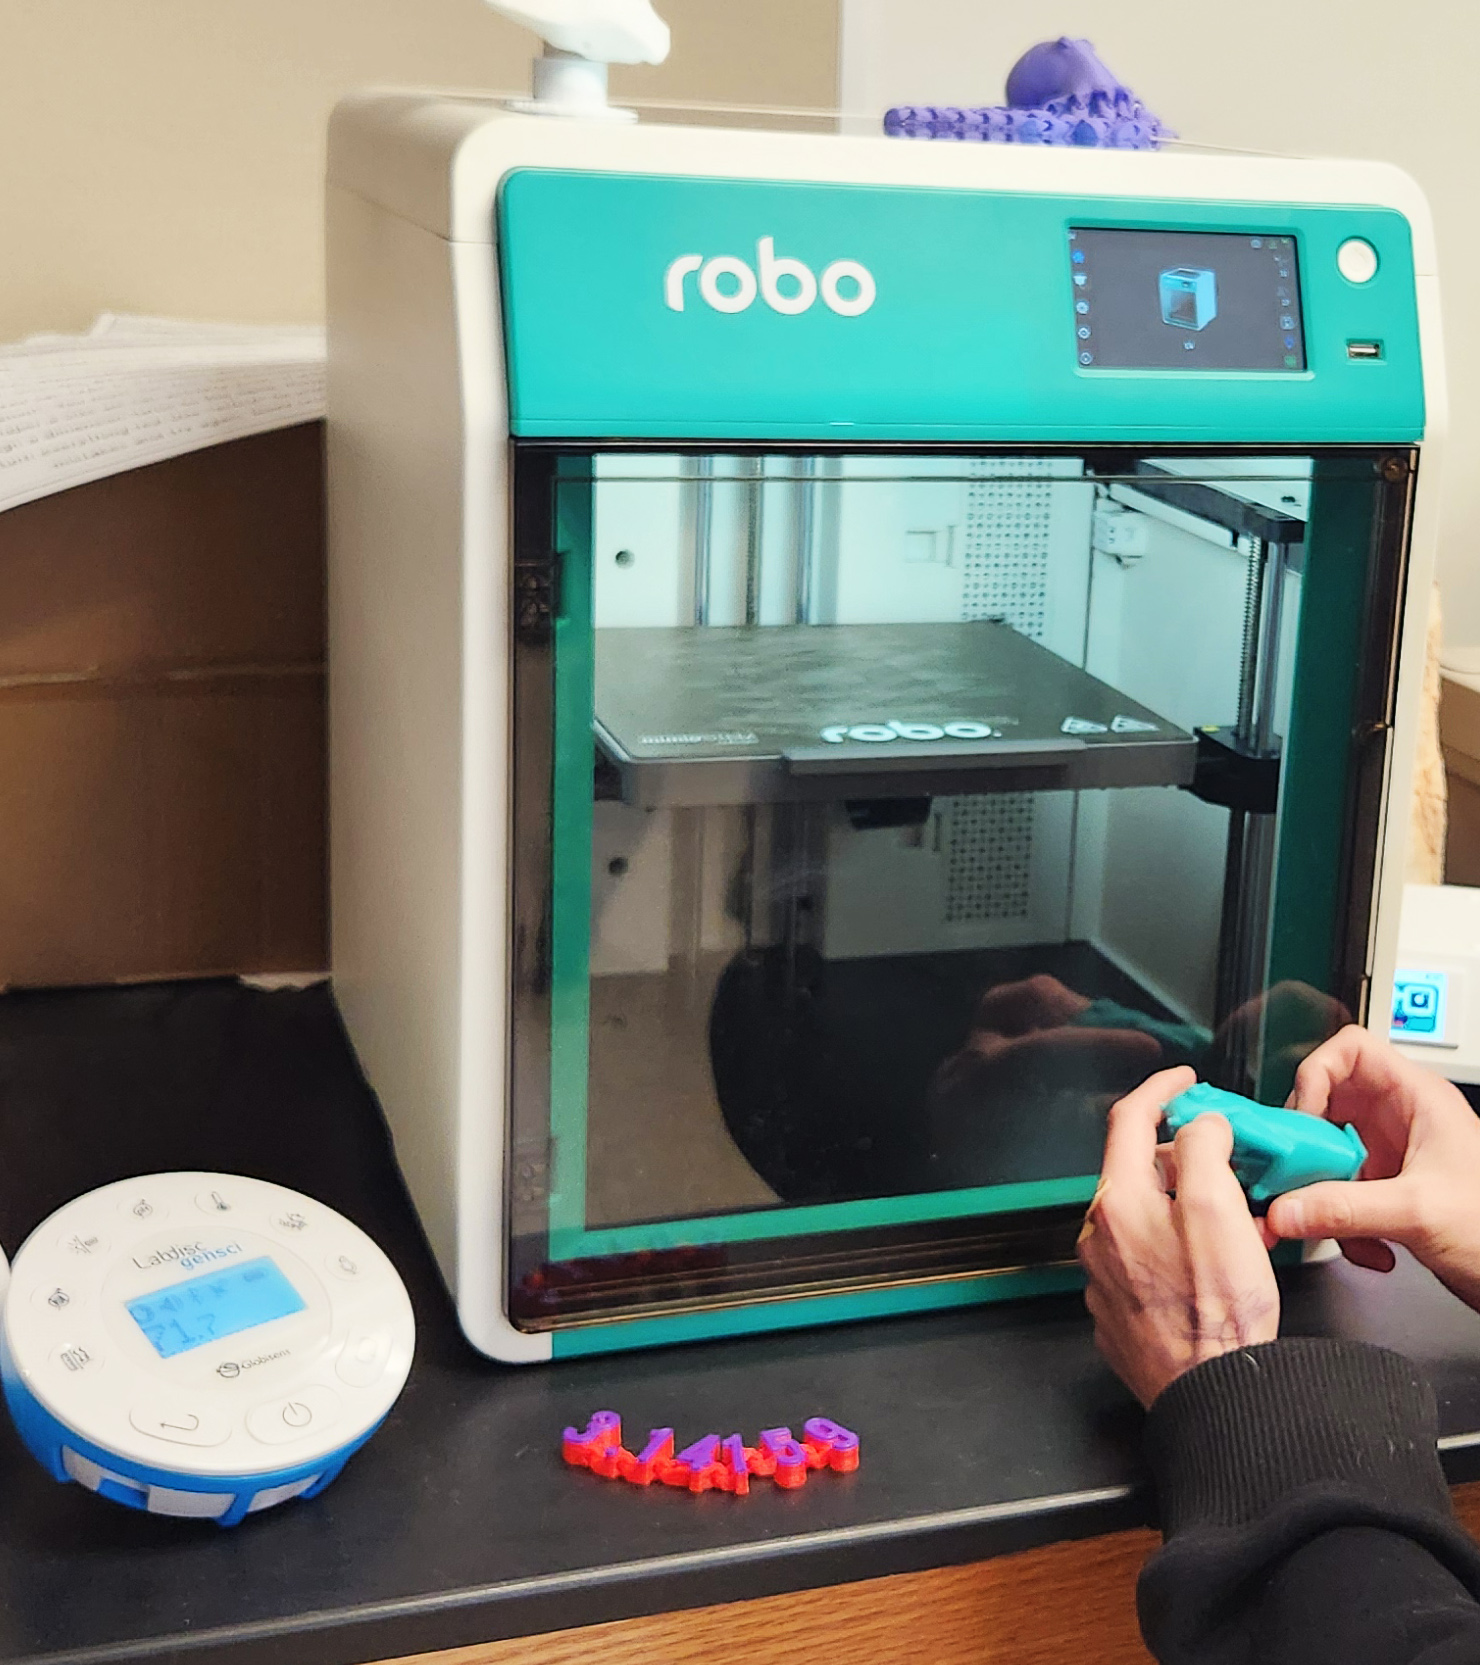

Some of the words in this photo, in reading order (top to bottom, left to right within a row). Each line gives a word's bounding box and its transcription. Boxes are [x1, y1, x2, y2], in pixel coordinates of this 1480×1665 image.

[664, 235, 876, 317] robo
[132, 1242, 206, 1269] Labdisc
[180, 1242, 243, 1270] gensci
